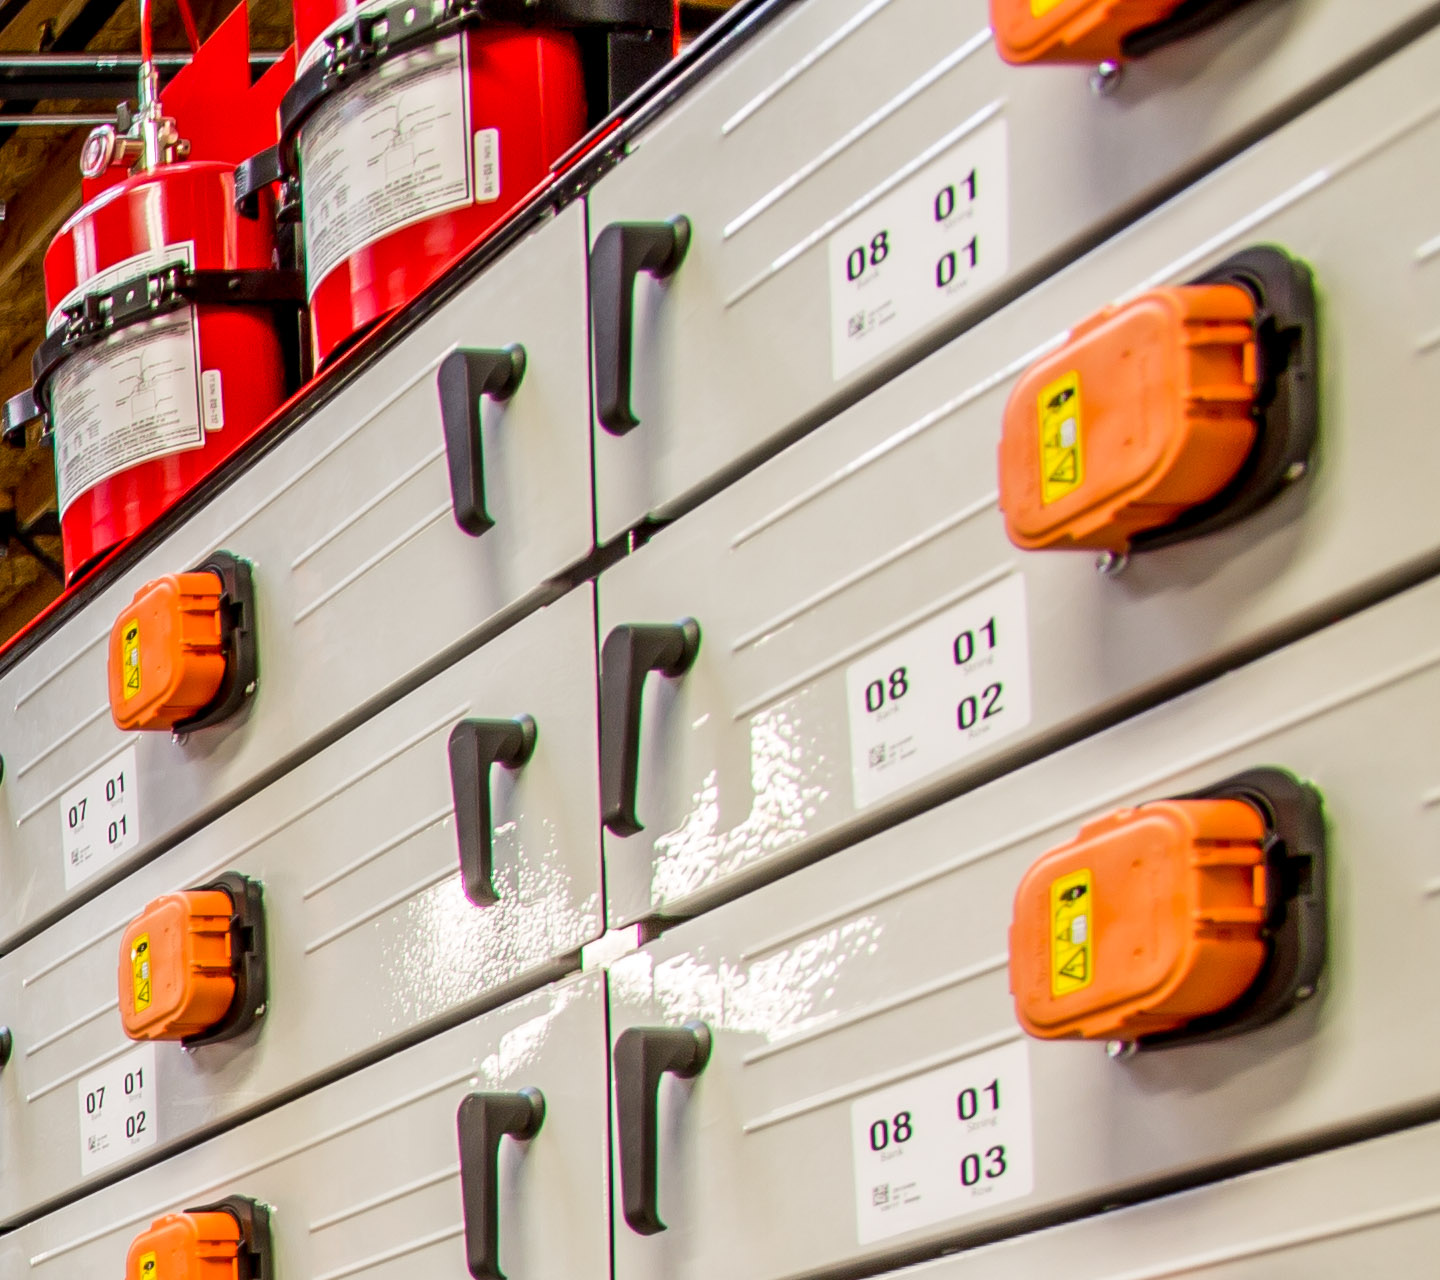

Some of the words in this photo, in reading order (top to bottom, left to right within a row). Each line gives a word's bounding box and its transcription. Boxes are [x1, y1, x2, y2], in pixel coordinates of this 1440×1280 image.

[935, 170, 976, 222] 01
[847, 231, 889, 282] 08
[936, 237, 977, 288] 01
[953, 618, 996, 665] 01
[865, 667, 908, 713] 08
[957, 683, 1002, 730] 02
[105, 772, 125, 802] 01
[68, 798, 87, 828] 07
[108, 814, 127, 844] 01
[86, 1086, 105, 1114] 07
[124, 1068, 143, 1095] 01
[957, 1079, 999, 1121] 01
[126, 1110, 146, 1138] 02
[870, 1111, 912, 1151] 08
[960, 1145, 1006, 1186] 03
